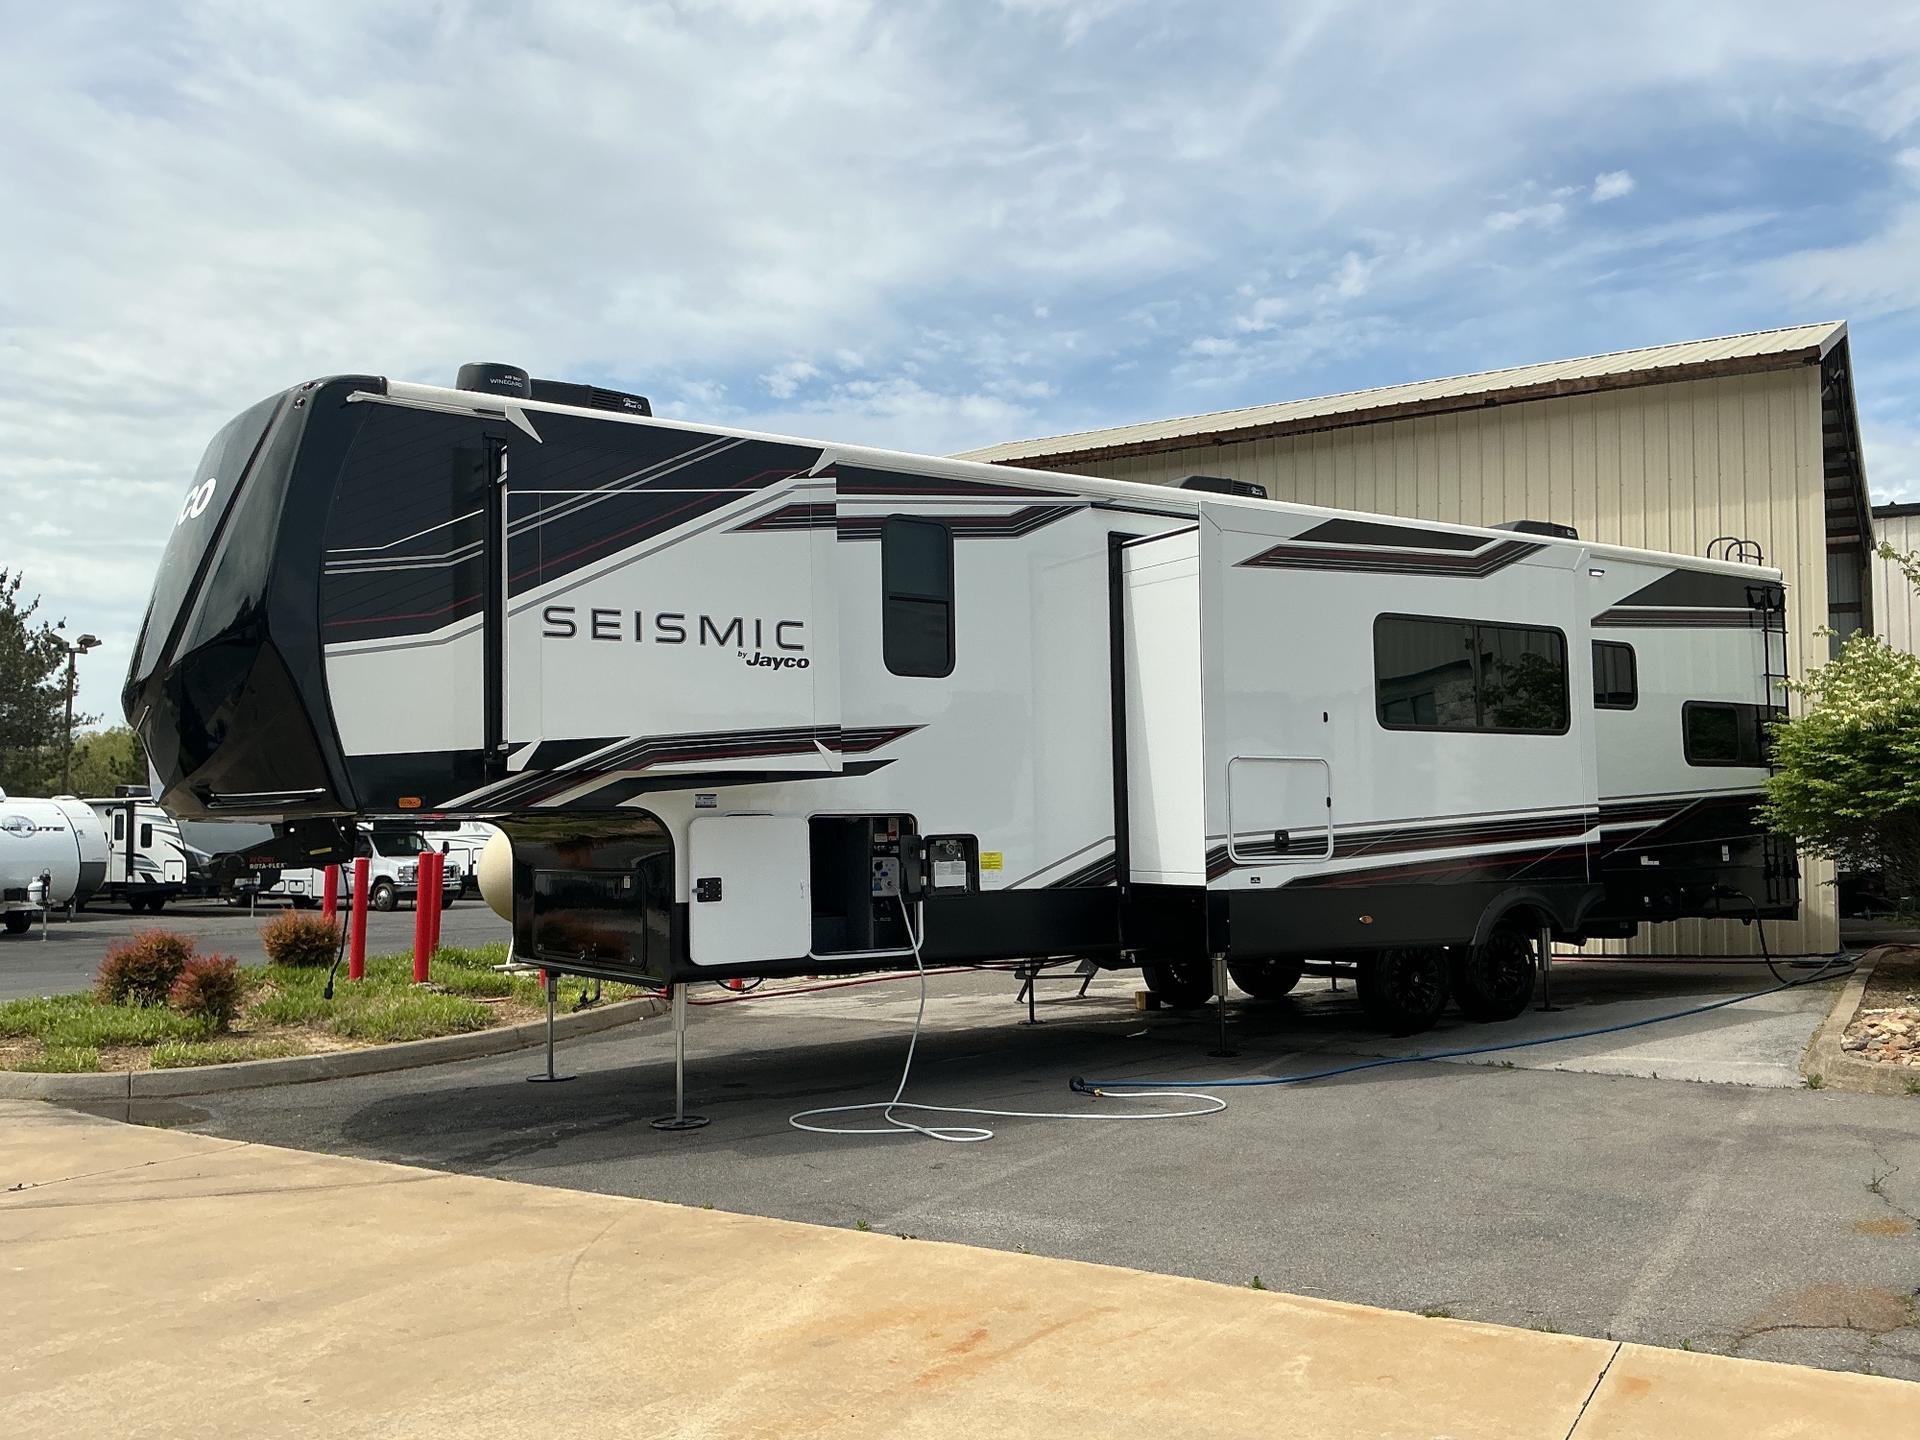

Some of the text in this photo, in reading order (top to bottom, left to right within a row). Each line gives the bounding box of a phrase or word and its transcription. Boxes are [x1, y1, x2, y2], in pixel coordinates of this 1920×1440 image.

[542, 605, 806, 651] SEISMIC
[737, 651, 810, 671] by Jayco
